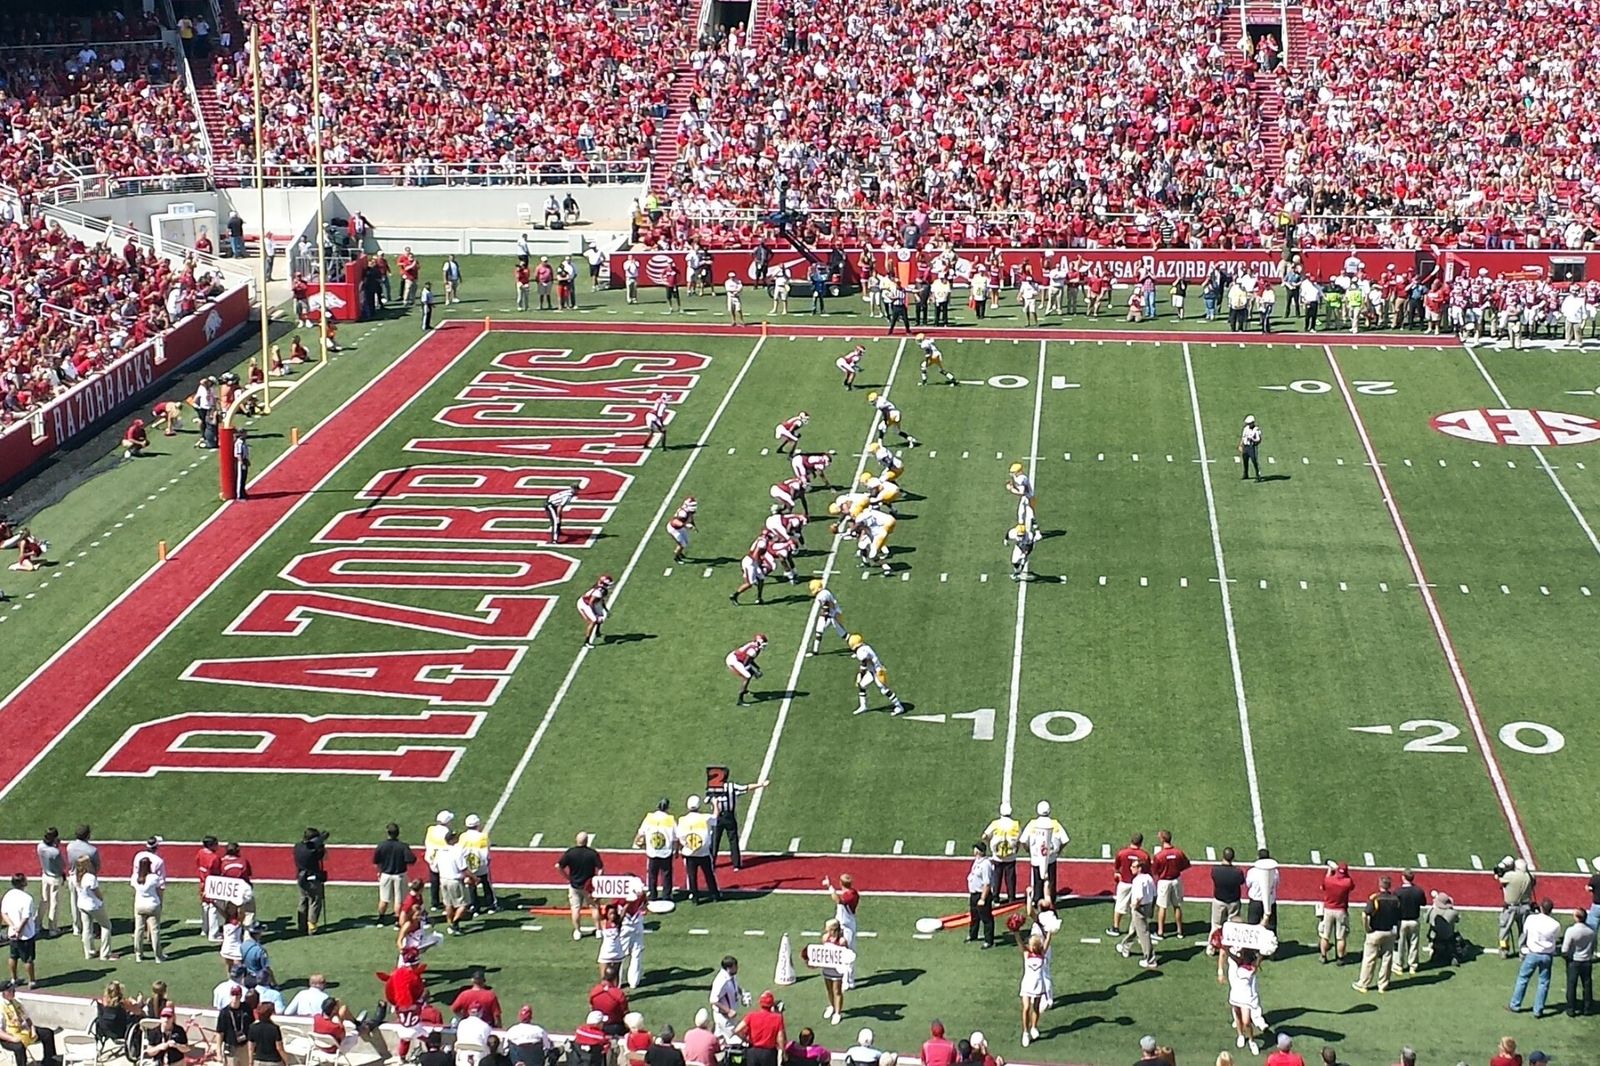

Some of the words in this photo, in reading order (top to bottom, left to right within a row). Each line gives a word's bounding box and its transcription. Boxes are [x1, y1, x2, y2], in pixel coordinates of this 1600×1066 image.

[53, 349, 152, 445] RAZORBACKS
[86, 348, 712, 784] RAZORBACKS
[708, 767, 724, 788] 2
[208, 879, 240, 898] NOISE
[596, 879, 630, 895] NOISE
[811, 947, 843, 965] DEFENSE
